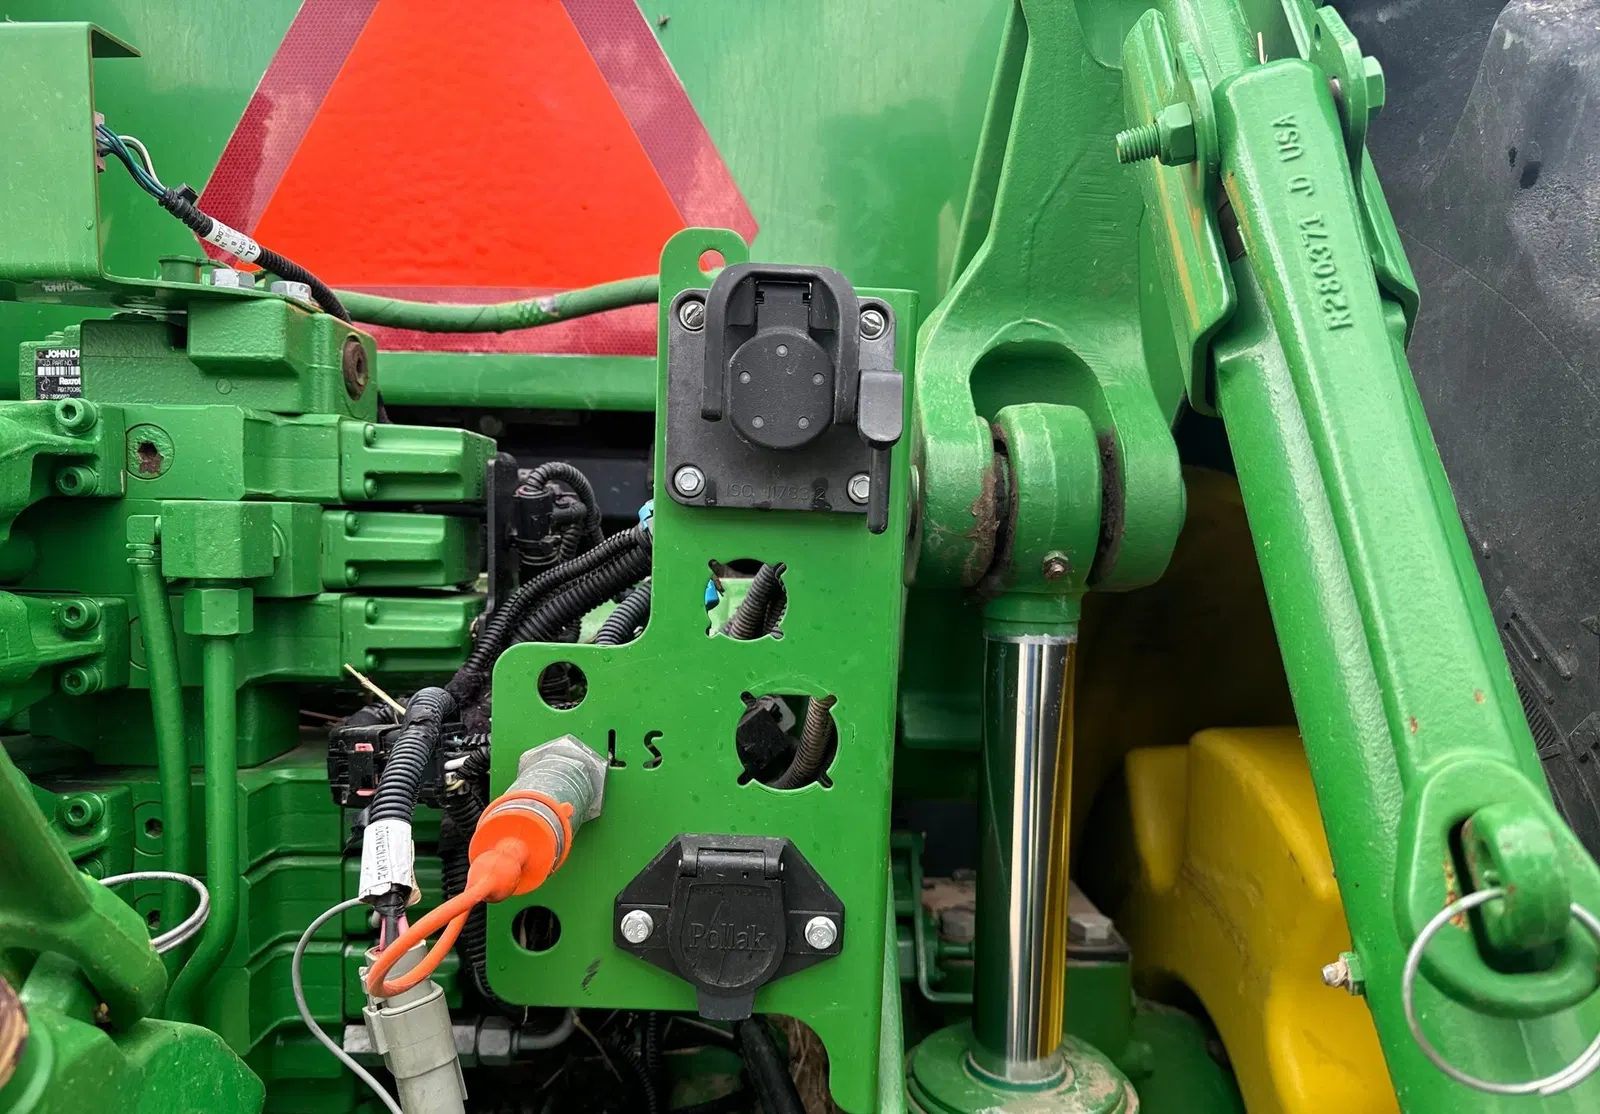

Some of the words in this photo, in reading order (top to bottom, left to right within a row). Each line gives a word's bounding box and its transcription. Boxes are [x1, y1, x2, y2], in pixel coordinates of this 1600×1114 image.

[1270, 112, 1303, 163] USA
[1298, 211, 1354, 331] R280371
[45, 349, 69, 358] JOHN
[689, 922, 767, 951] Pollak
